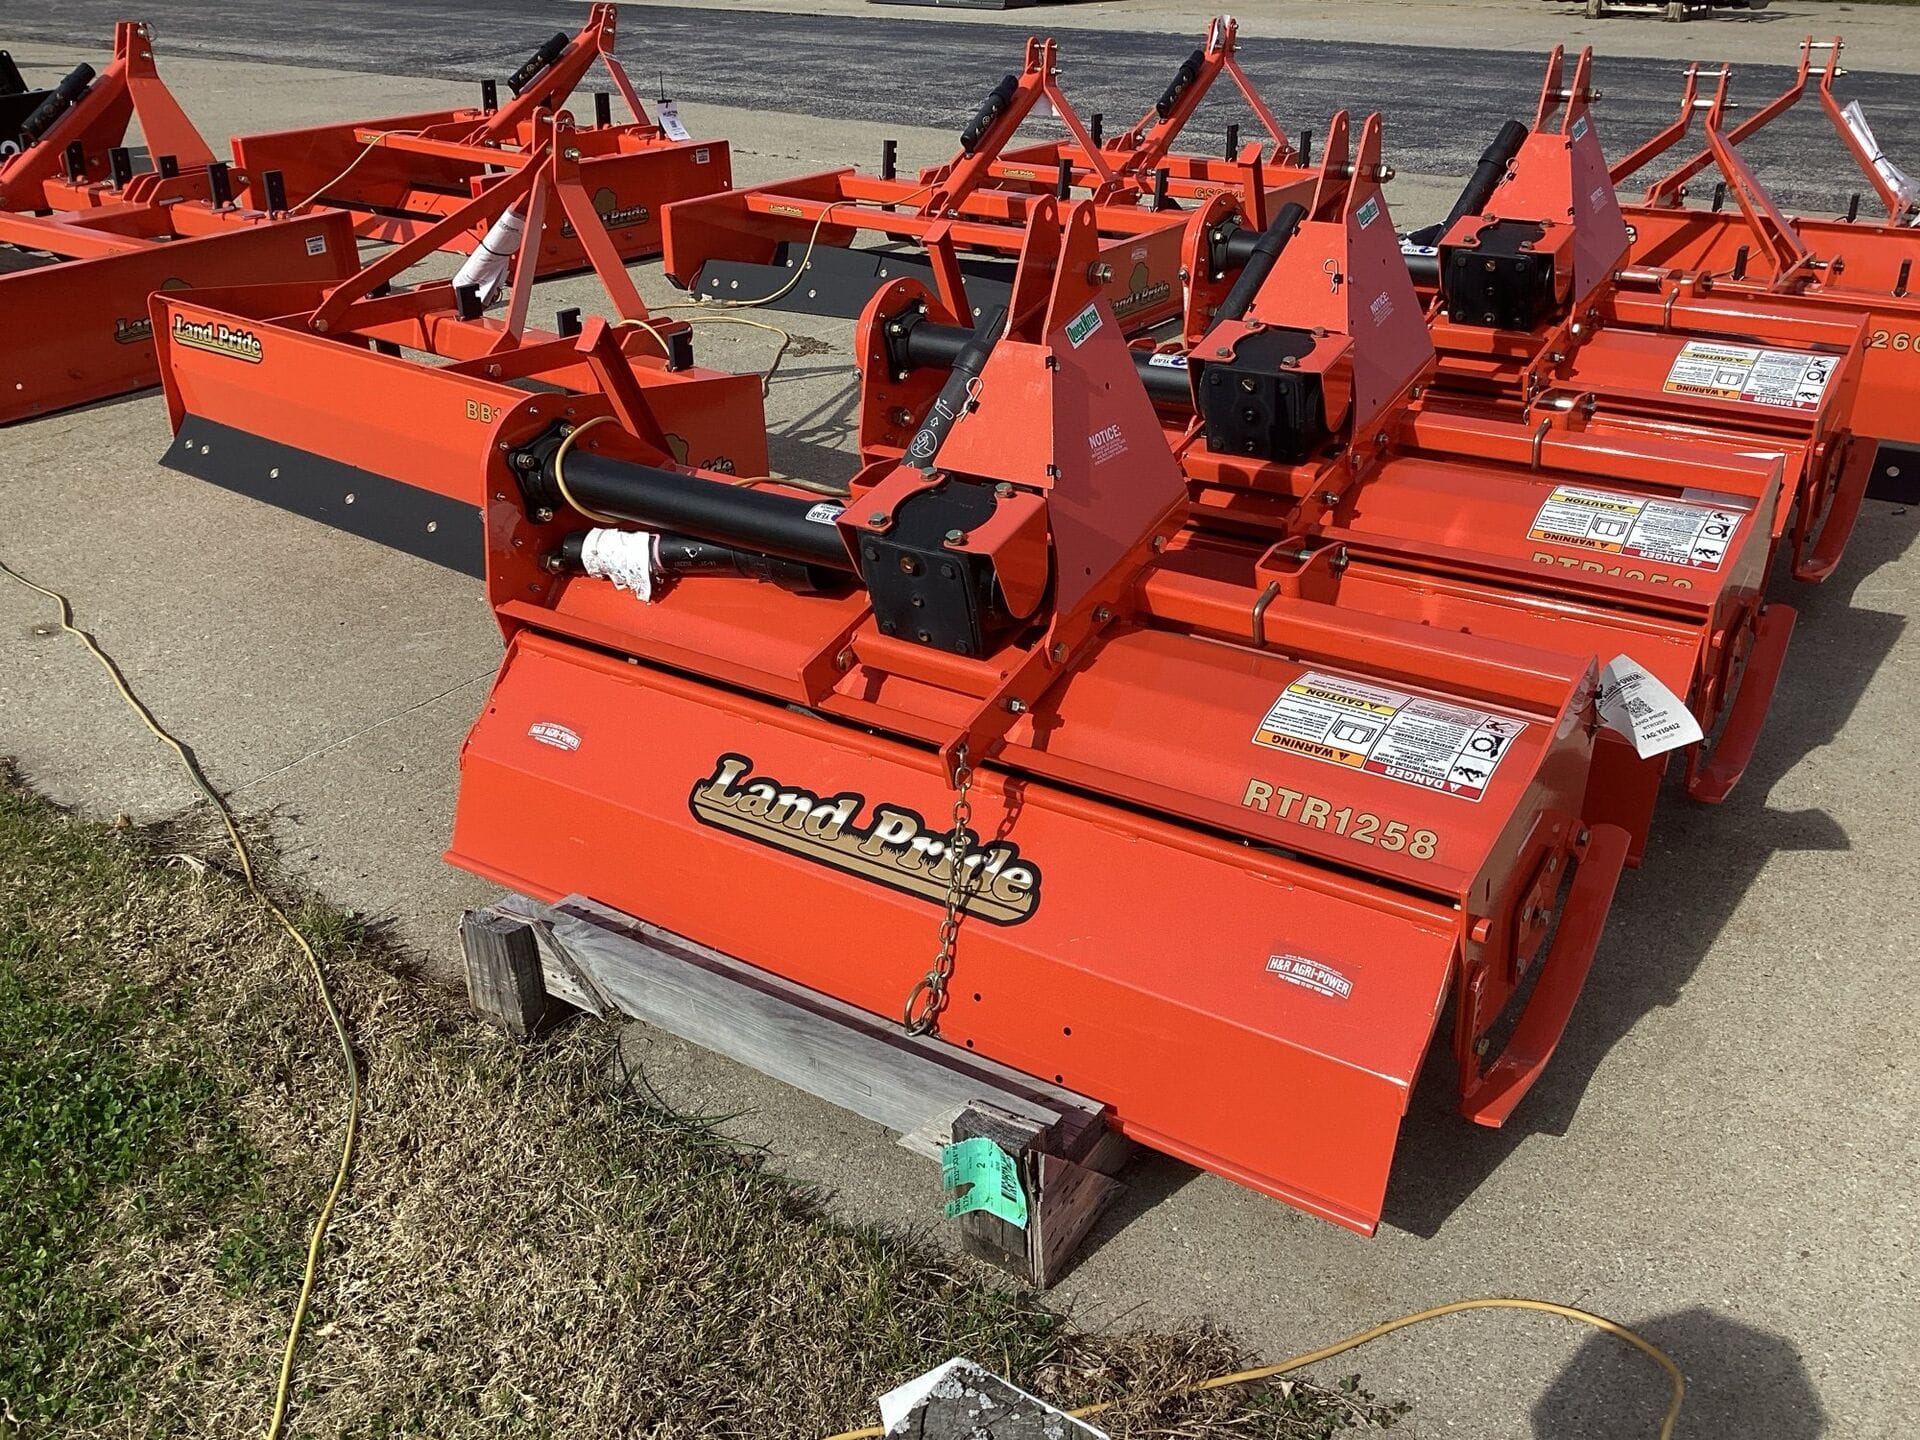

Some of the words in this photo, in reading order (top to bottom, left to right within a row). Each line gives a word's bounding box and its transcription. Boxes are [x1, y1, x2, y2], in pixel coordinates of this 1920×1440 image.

[174, 315, 213, 344] Land
[217, 325, 262, 356] Pride
[1676, 384, 1719, 396] WARNING
[1754, 396, 1792, 408] DANGER
[1088, 424, 1121, 448] NOTICE:
[1565, 498, 1614, 510] CAUTION
[811, 511, 830, 521] YEAR
[1543, 533, 1596, 547] WARNING
[1639, 551, 1686, 566] DANGER
[1307, 688, 1367, 708] CAUTION
[1272, 734, 1334, 759] WARNING
[1385, 766, 1445, 791] DANGER
[1241, 778, 1438, 860] RTR1258
[700, 758, 859, 841] Land
[856, 809, 1036, 904] Pride
[1268, 958, 1292, 972] H&R
[1291, 962, 1350, 996] AGRI-POWER
